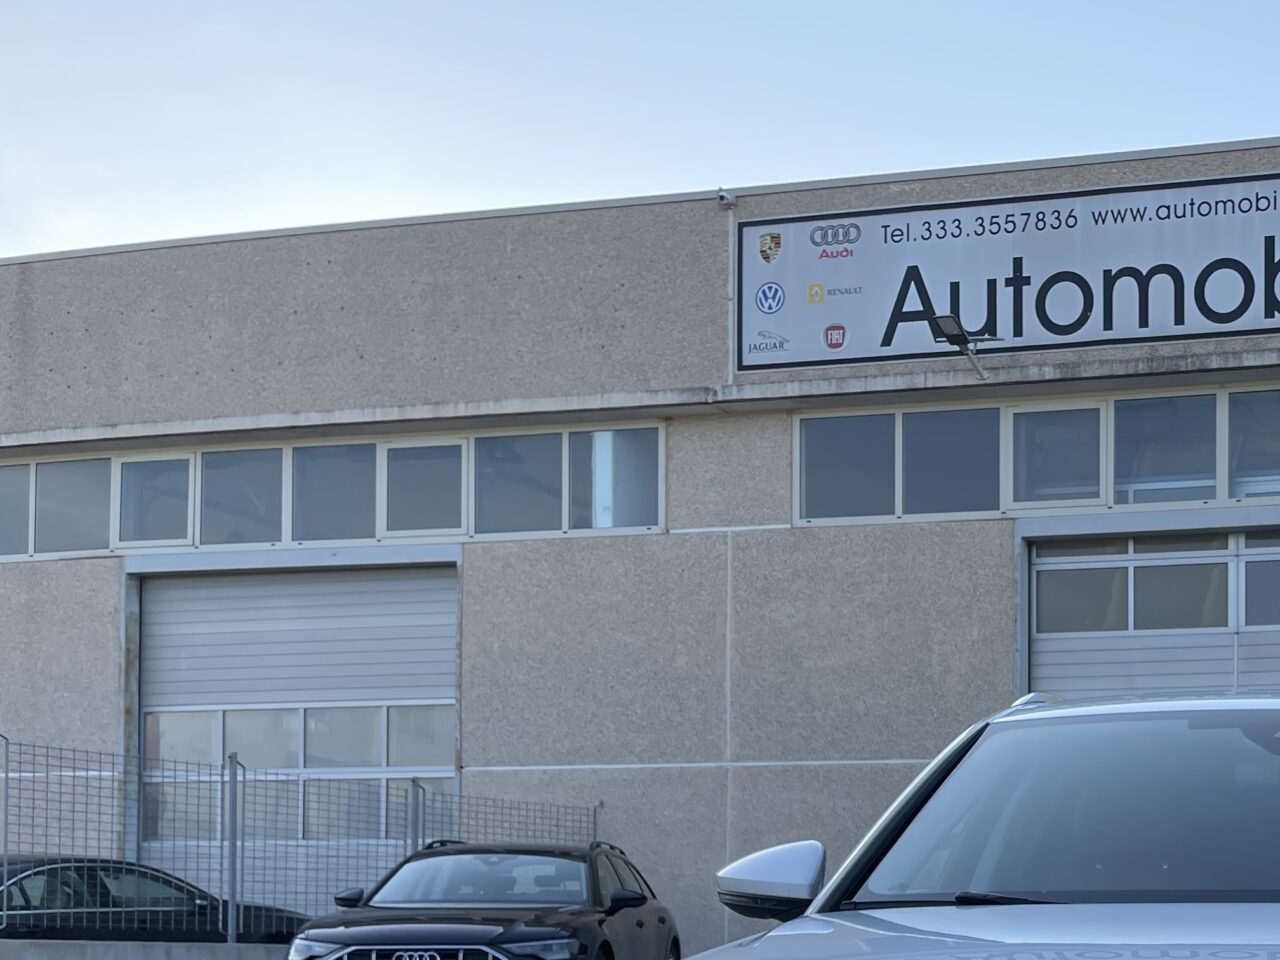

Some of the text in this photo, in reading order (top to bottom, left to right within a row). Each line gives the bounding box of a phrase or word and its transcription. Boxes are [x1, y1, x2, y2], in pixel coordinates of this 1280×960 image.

[881, 208, 1078, 244] Tel.333.3557836
[818, 247, 853, 259] Audi
[826, 286, 864, 296] RENAULT
[827, 329, 844, 345] FIAT
[748, 341, 785, 354] JAGUAR
